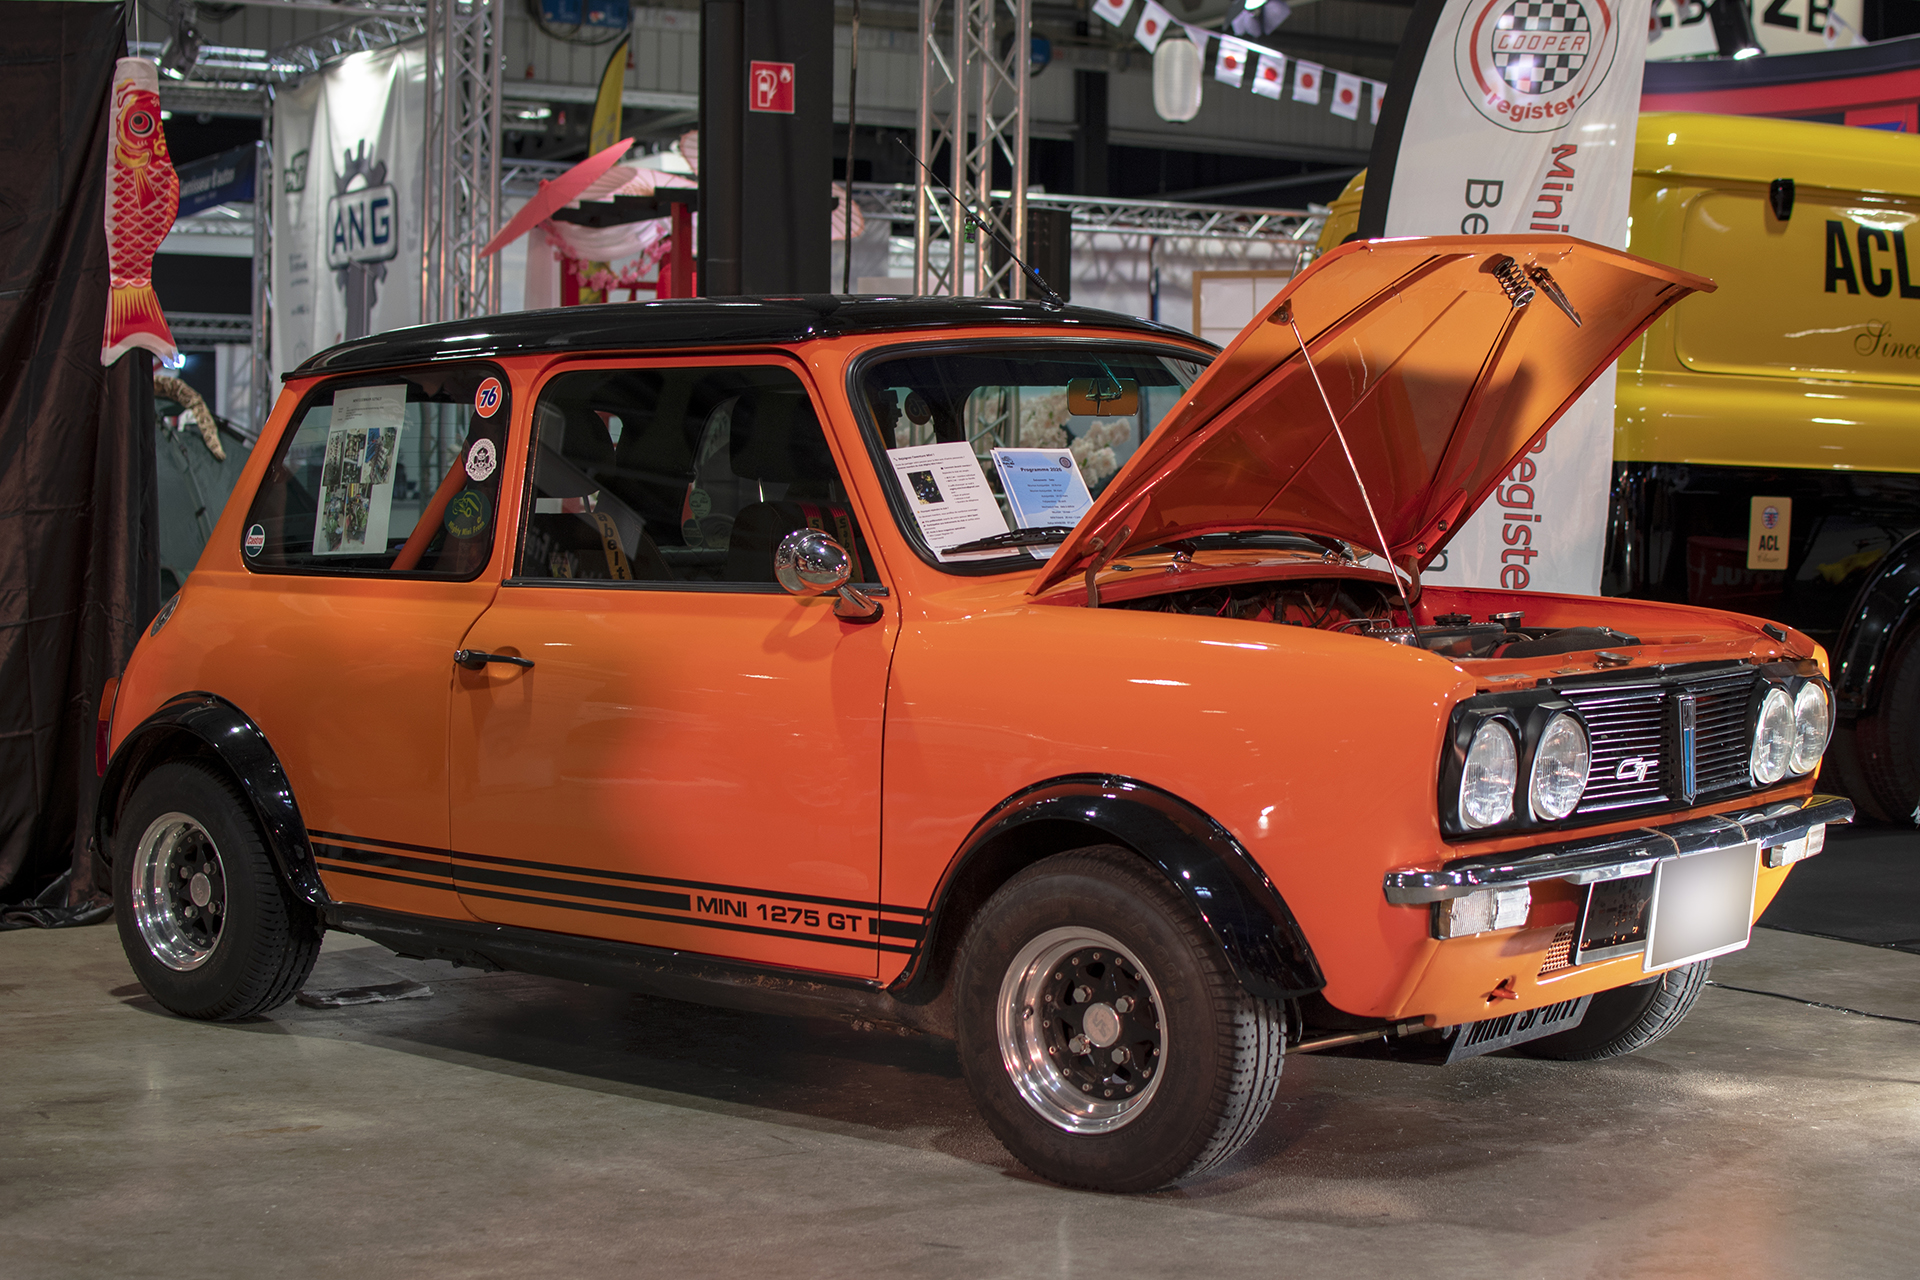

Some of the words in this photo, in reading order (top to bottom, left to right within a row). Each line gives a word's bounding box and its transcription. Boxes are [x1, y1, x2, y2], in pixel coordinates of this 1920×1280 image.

[1497, 34, 1586, 51] COOPER
[1487, 93, 1575, 122] register
[1530, 144, 1578, 232] Mini
[332, 198, 389, 254] ANG
[1824, 219, 1920, 299] ACL
[1854, 318, 1920, 359] Since
[479, 385, 498, 408] 76
[1758, 535, 1780, 551] ACL
[1616, 757, 1660, 782] GT
[697, 895, 747, 918] MINI
[756, 904, 820, 927] 1275
[827, 912, 862, 932] GT
